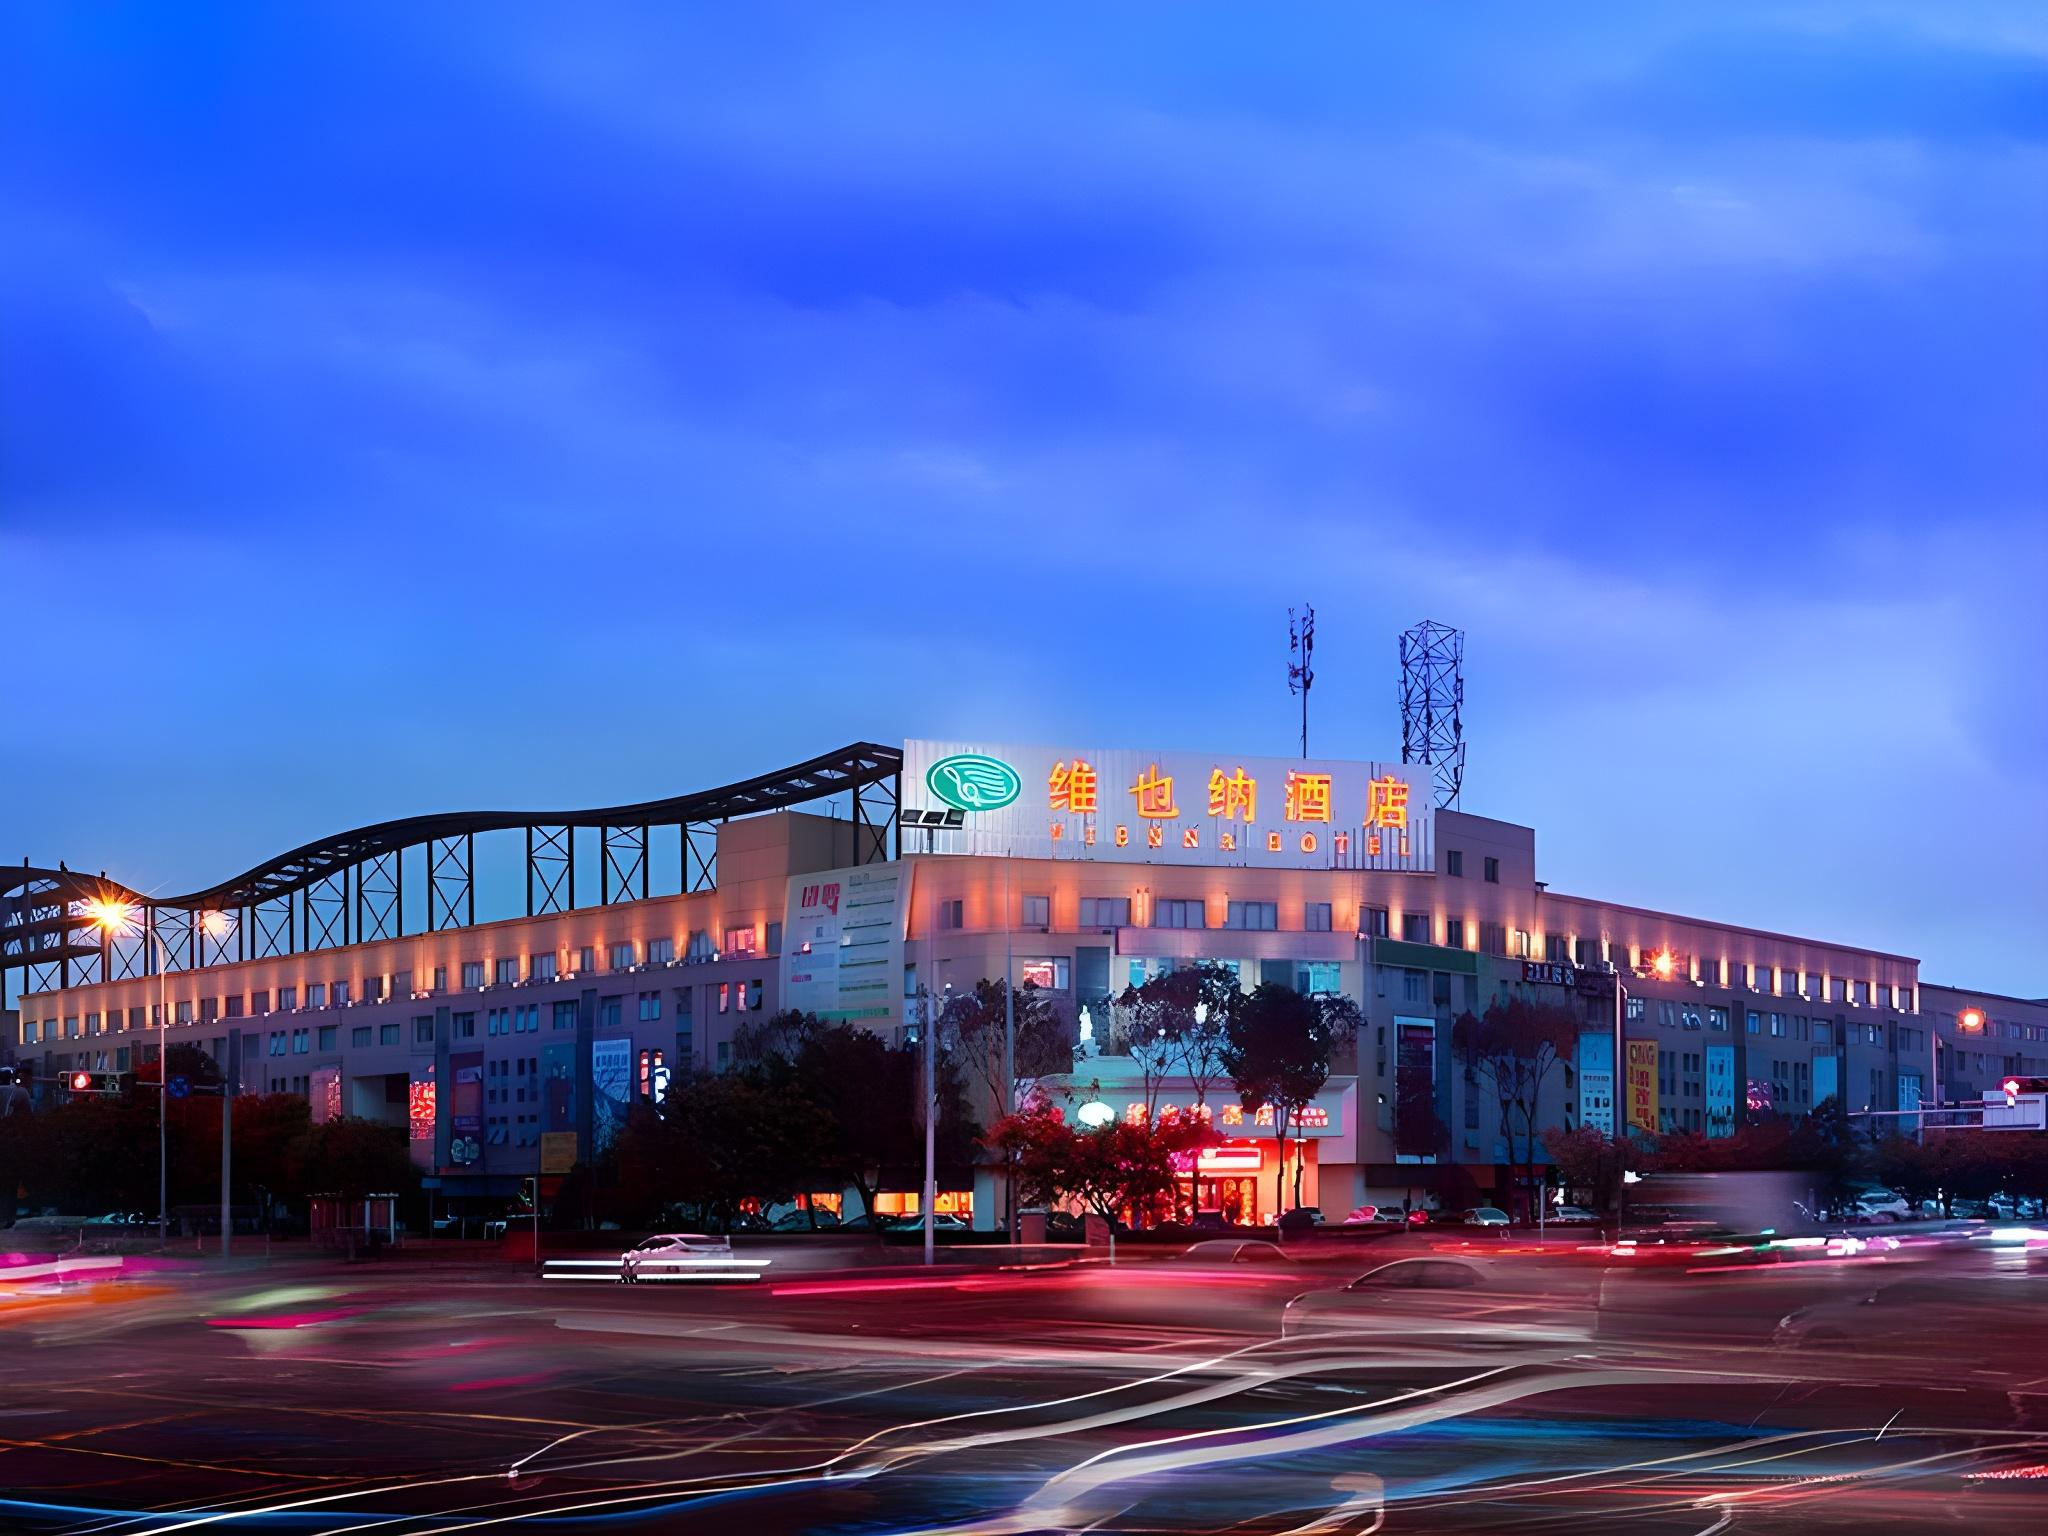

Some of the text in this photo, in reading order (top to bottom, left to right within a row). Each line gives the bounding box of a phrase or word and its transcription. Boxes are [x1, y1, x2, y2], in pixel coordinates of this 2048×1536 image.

[1047, 758, 1410, 829] 维也纳酒店
